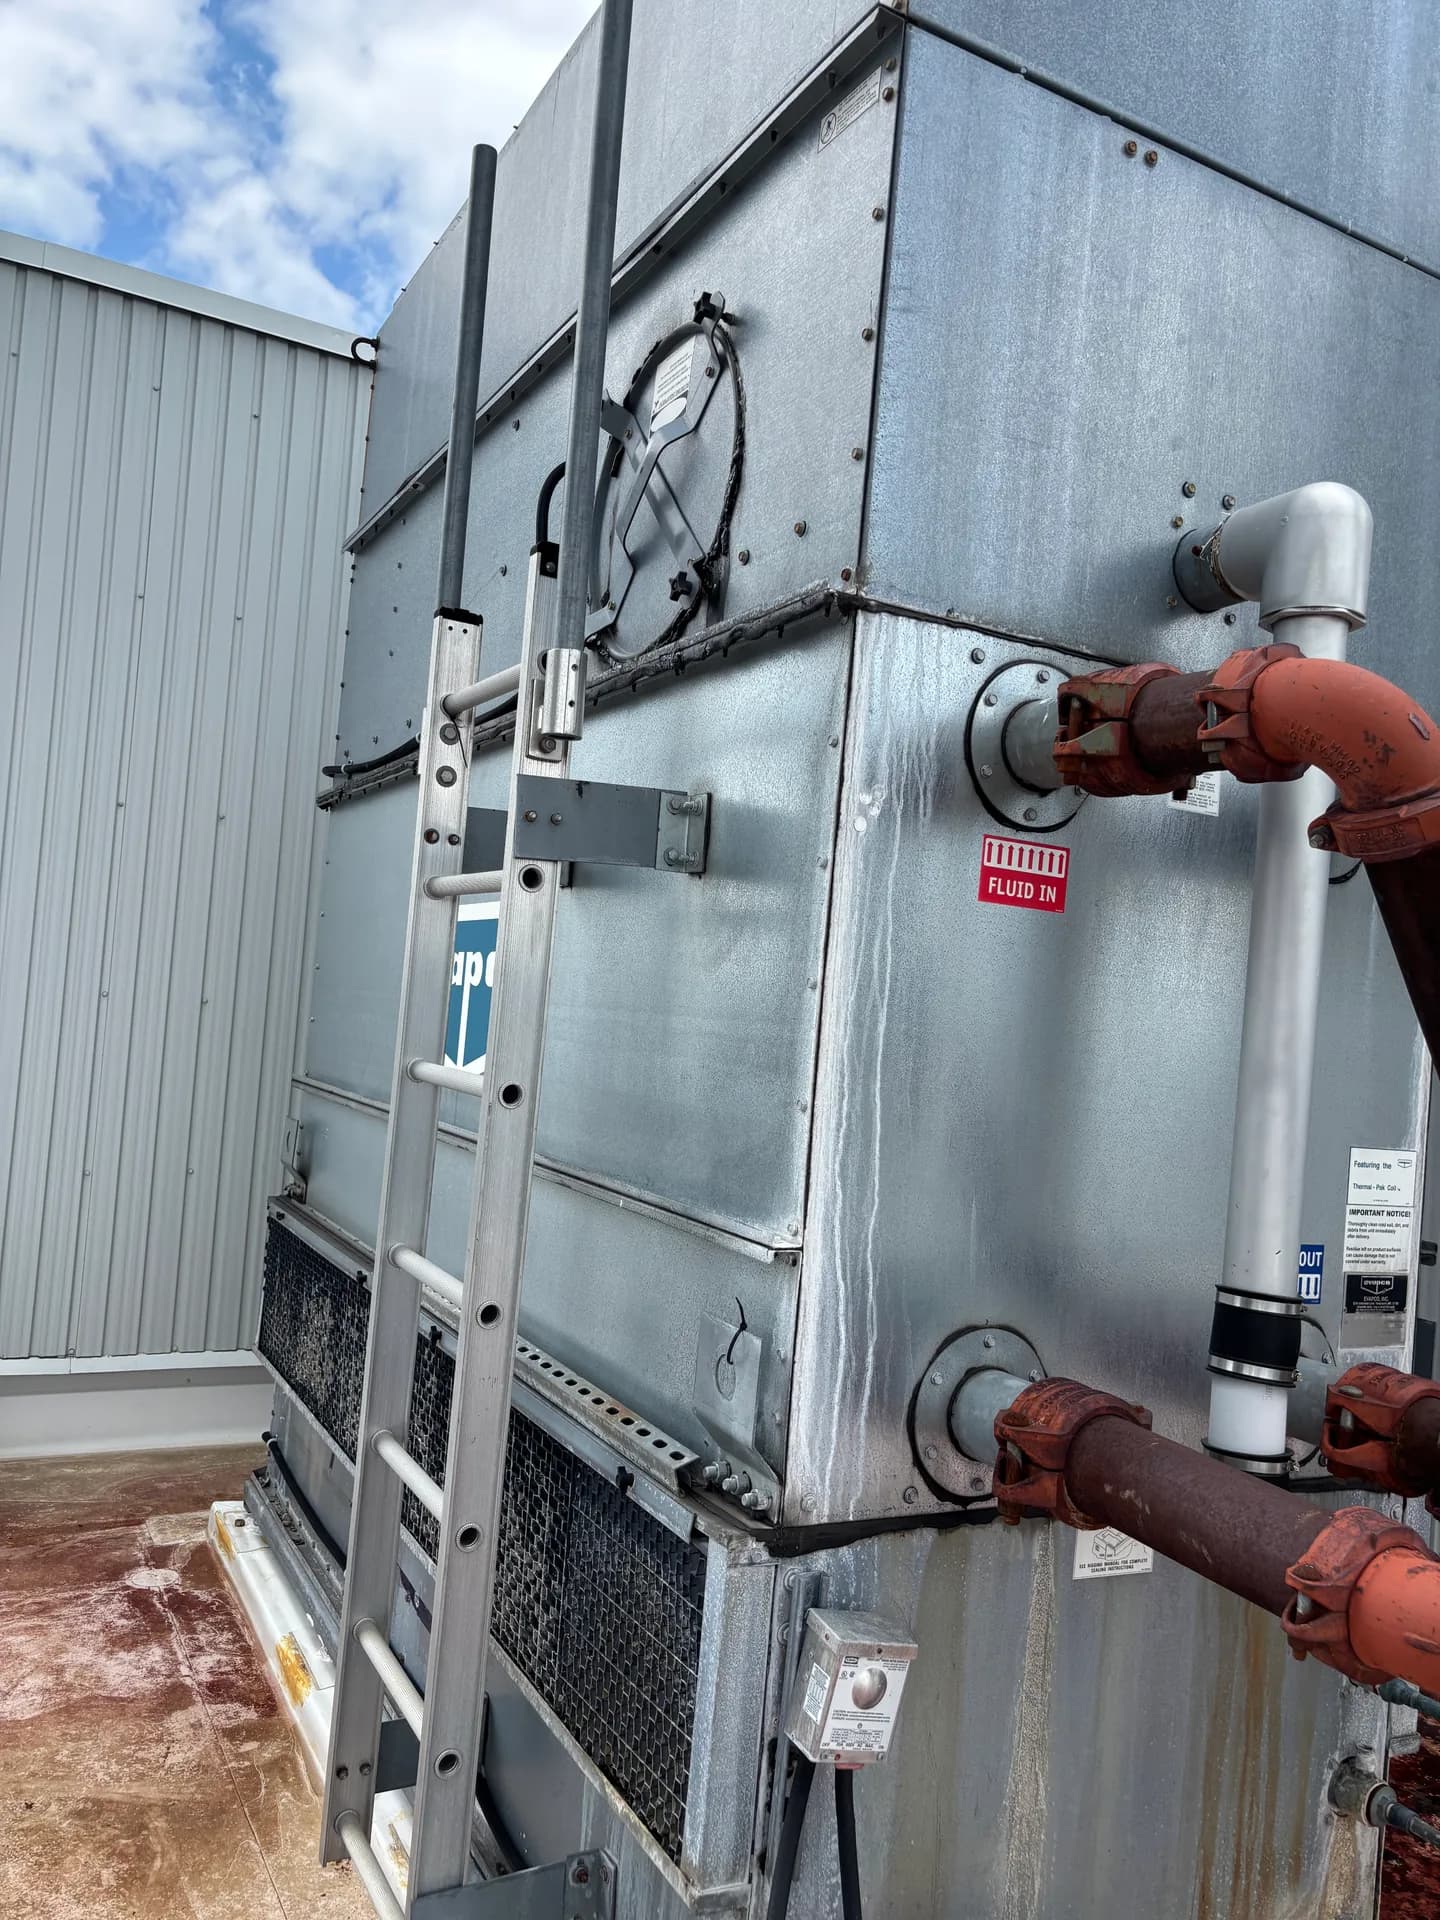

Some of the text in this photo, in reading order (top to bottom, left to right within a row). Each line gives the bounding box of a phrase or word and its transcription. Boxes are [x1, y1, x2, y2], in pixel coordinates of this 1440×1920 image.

[988, 876, 1057, 904] FLUID IN
[1353, 1160, 1380, 1170] Featuring
[1386, 1210, 1411, 1218] NOTICE!
[1299, 1251, 1323, 1267] OUT
